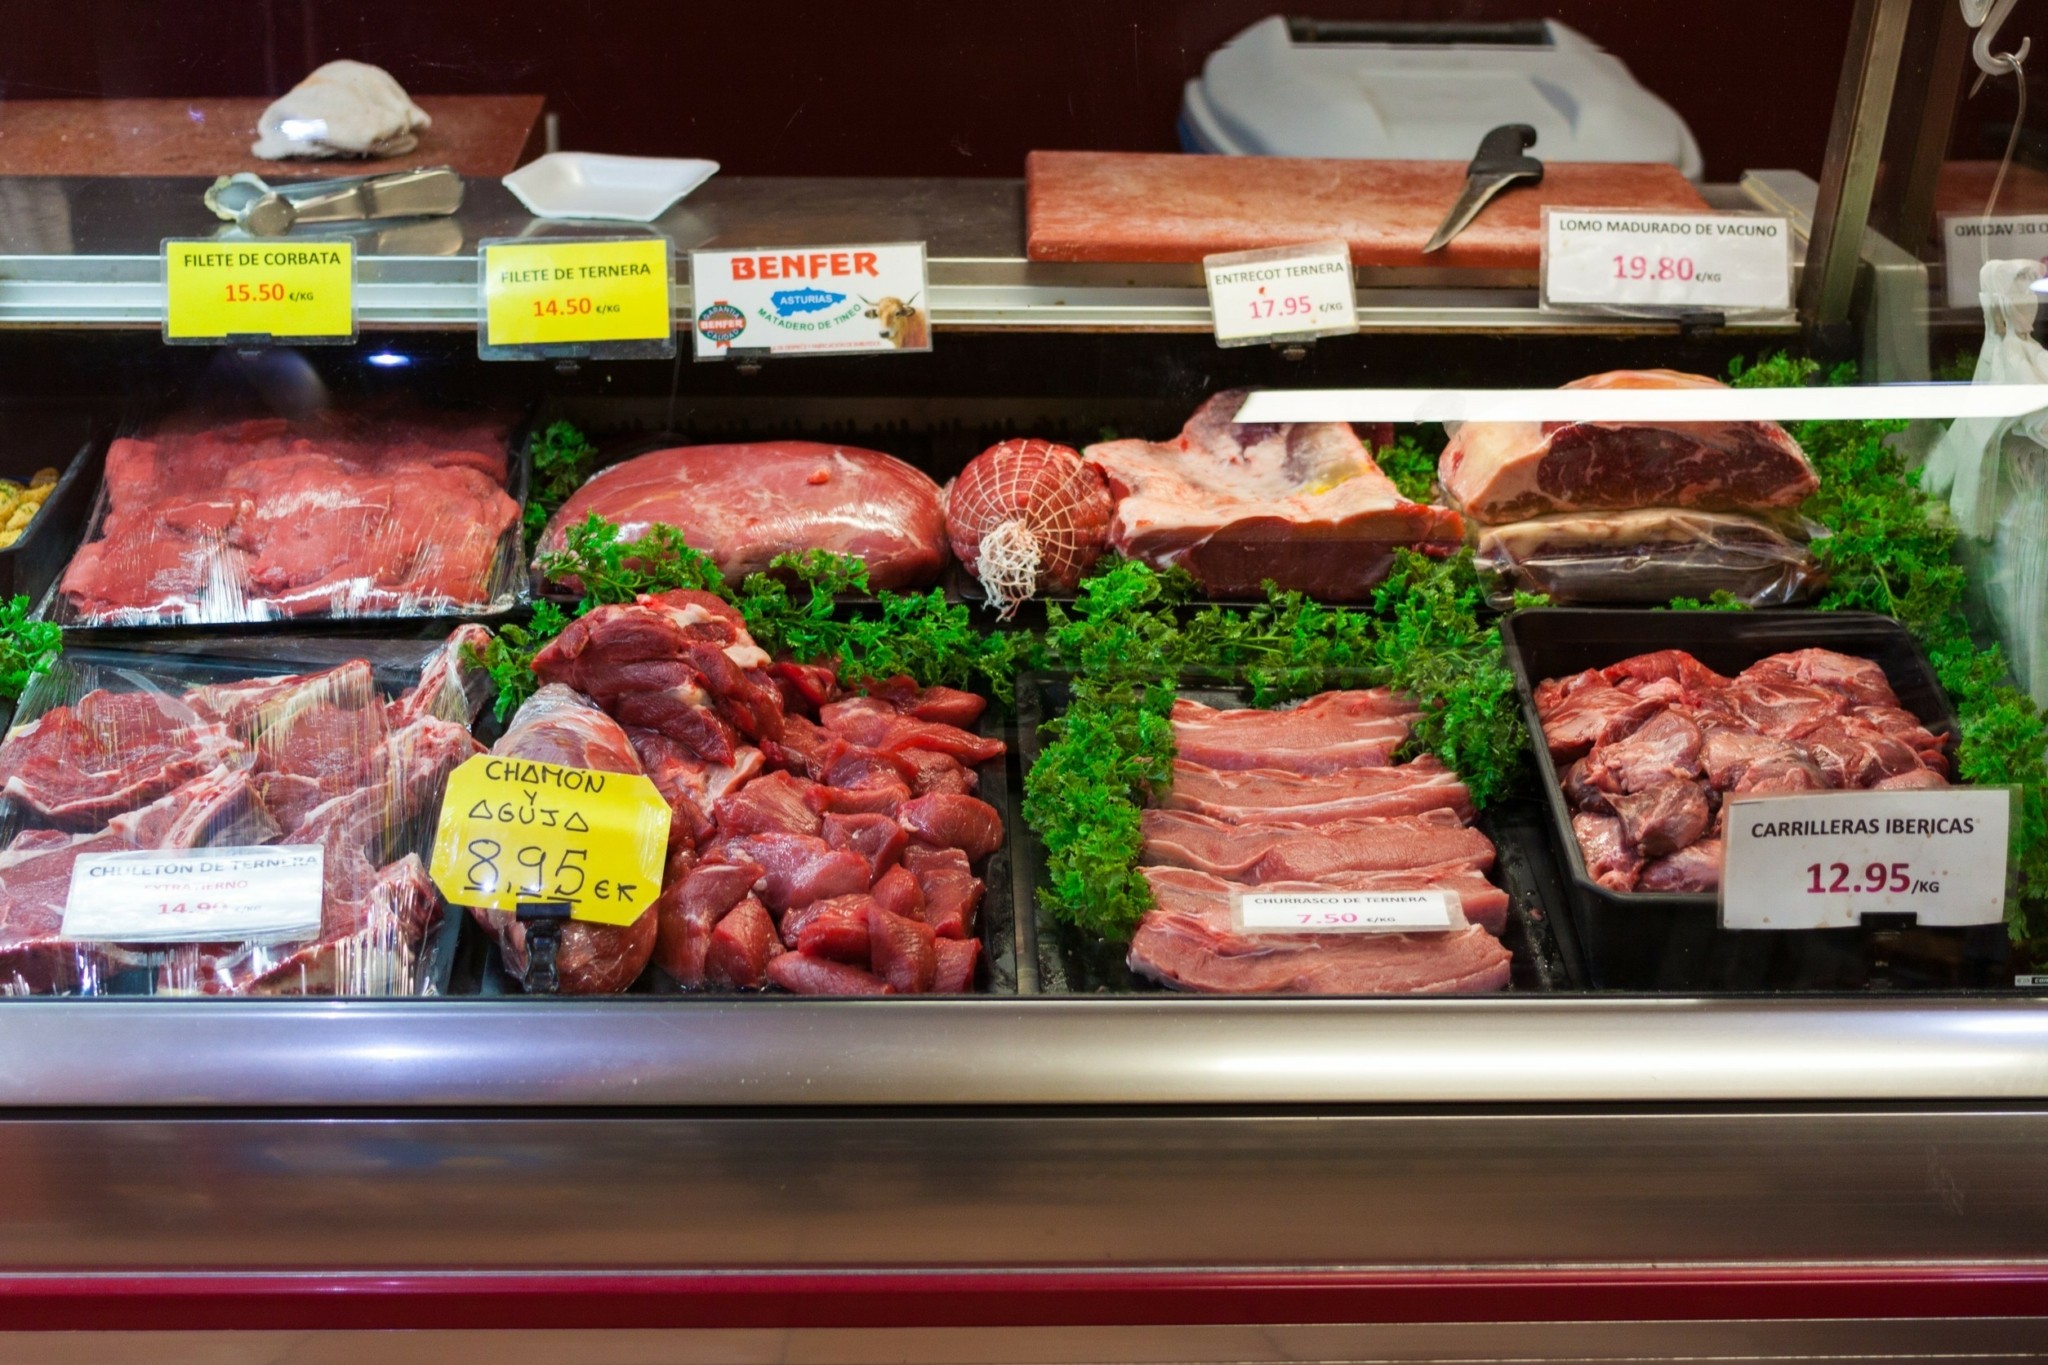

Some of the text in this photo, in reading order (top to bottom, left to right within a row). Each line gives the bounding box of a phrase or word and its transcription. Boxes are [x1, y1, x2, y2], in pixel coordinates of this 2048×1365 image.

[1559, 219, 1777, 237] LOMO MADURADO DE VACUNO
[184, 251, 341, 267] FILETE DE CORBATA
[731, 252, 880, 281] BENFER
[501, 263, 651, 283] FILETE DE TERNERA
[1215, 262, 1344, 285] ENTRECOT TERNERA
[225, 283, 314, 302] 15.50 €/KG
[780, 294, 833, 305] ASTURIAS
[533, 297, 621, 317] 14.50 €/KG
[1249, 295, 1343, 320] 17.95 €/KG
[757, 303, 862, 331] MATADERO DE TINEO
[523, 789, 537, 805] Y
[468, 799, 589, 833] AGUJA
[1751, 817, 1974, 838] CARRILLERAS IBERICAS
[200, 862, 224, 873] DE
[1254, 896, 1428, 905] CHURRASCO DE TERNERA
[1296, 912, 1358, 925] 7.50
